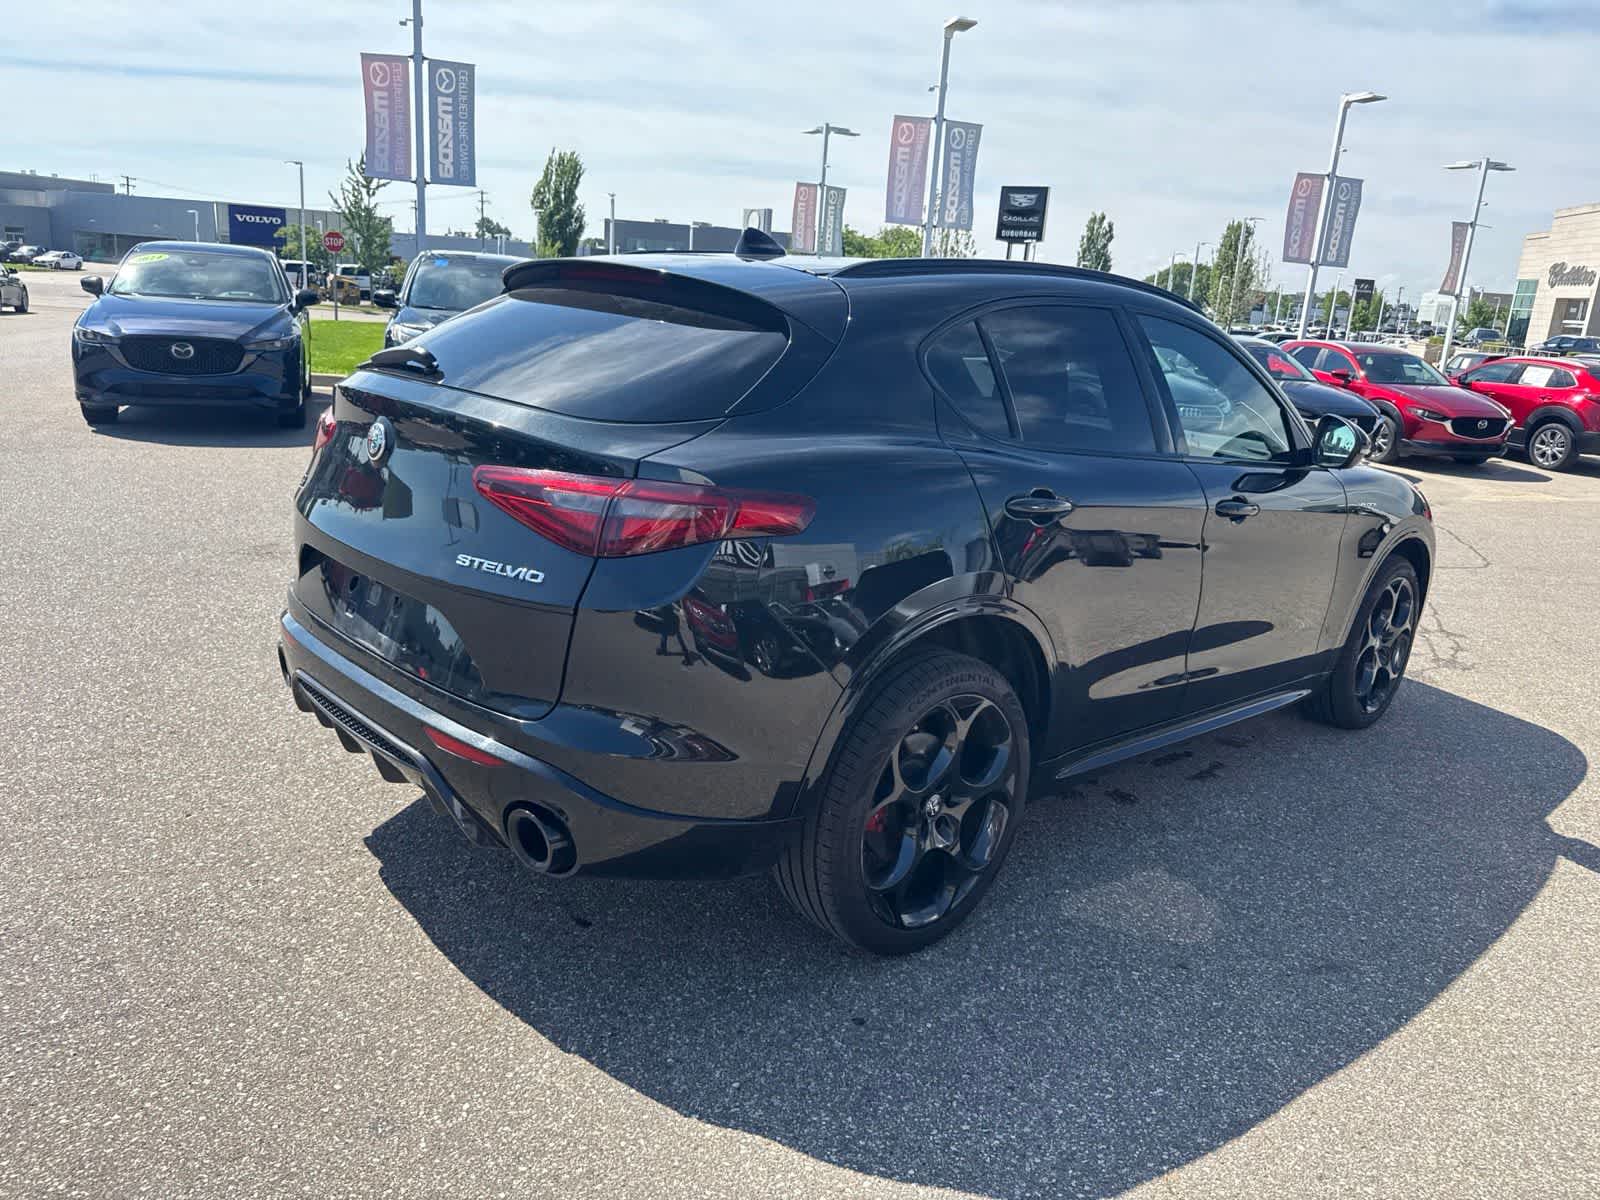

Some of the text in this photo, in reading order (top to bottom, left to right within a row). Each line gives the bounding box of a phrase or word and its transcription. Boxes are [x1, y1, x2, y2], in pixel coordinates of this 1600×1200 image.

[235, 213, 281, 225] VOLVO
[1002, 215, 1039, 223] CADILLAC
[1001, 230, 1037, 238] SUBURBAN
[325, 237, 344, 247] STOP
[455, 553, 545, 584] STELVIO
